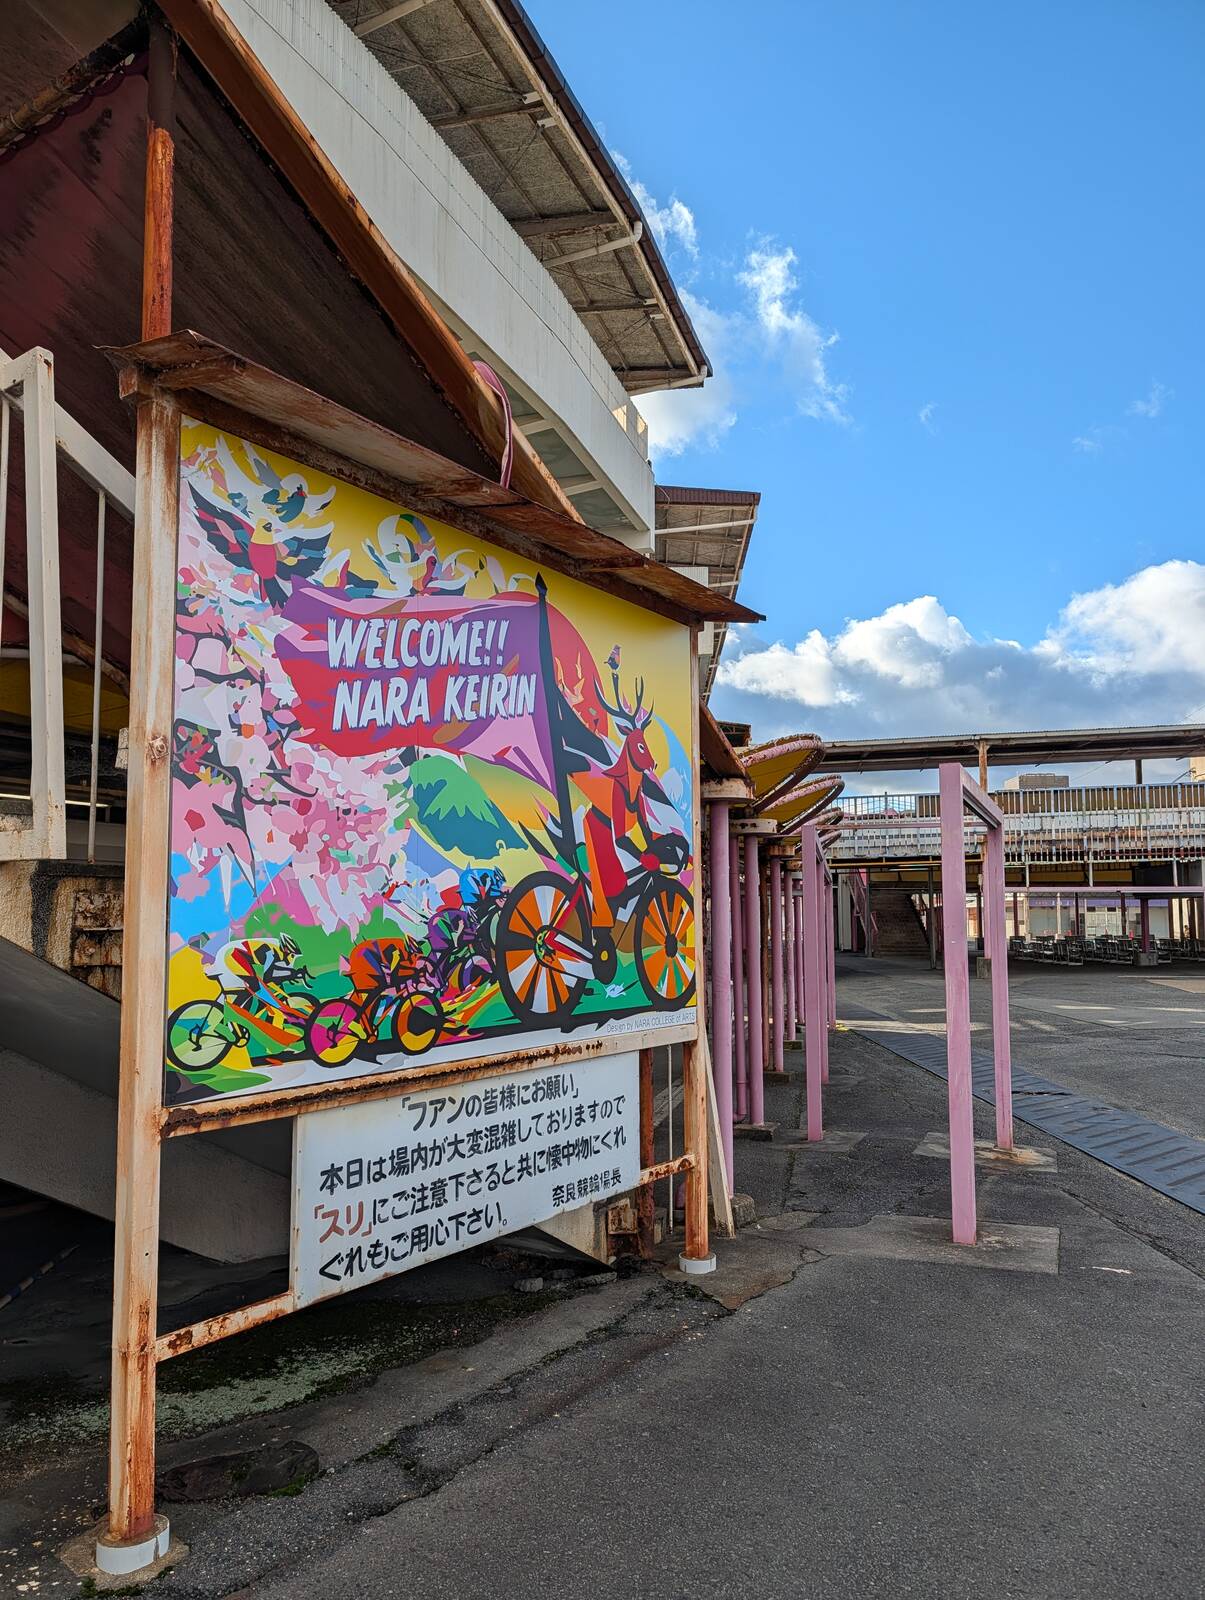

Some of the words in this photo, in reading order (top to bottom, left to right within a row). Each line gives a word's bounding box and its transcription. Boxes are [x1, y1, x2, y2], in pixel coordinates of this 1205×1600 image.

[327, 616, 510, 669] WELCOME!!
[332, 676, 431, 732] NARA
[443, 672, 537, 721] KEIRIN
[607, 1023, 627, 1033] Design
[635, 1019, 650, 1029] NARA
[652, 1015, 675, 1027] COLLEGE
[682, 1012, 695, 1021] ARTS
[319, 1095, 626, 1196] 本日は場内が大変混雑しておりますので
[552, 1166, 622, 1208] 奈良競輪場長
[318, 1201, 508, 1281] ぐれもご用心下さい。
